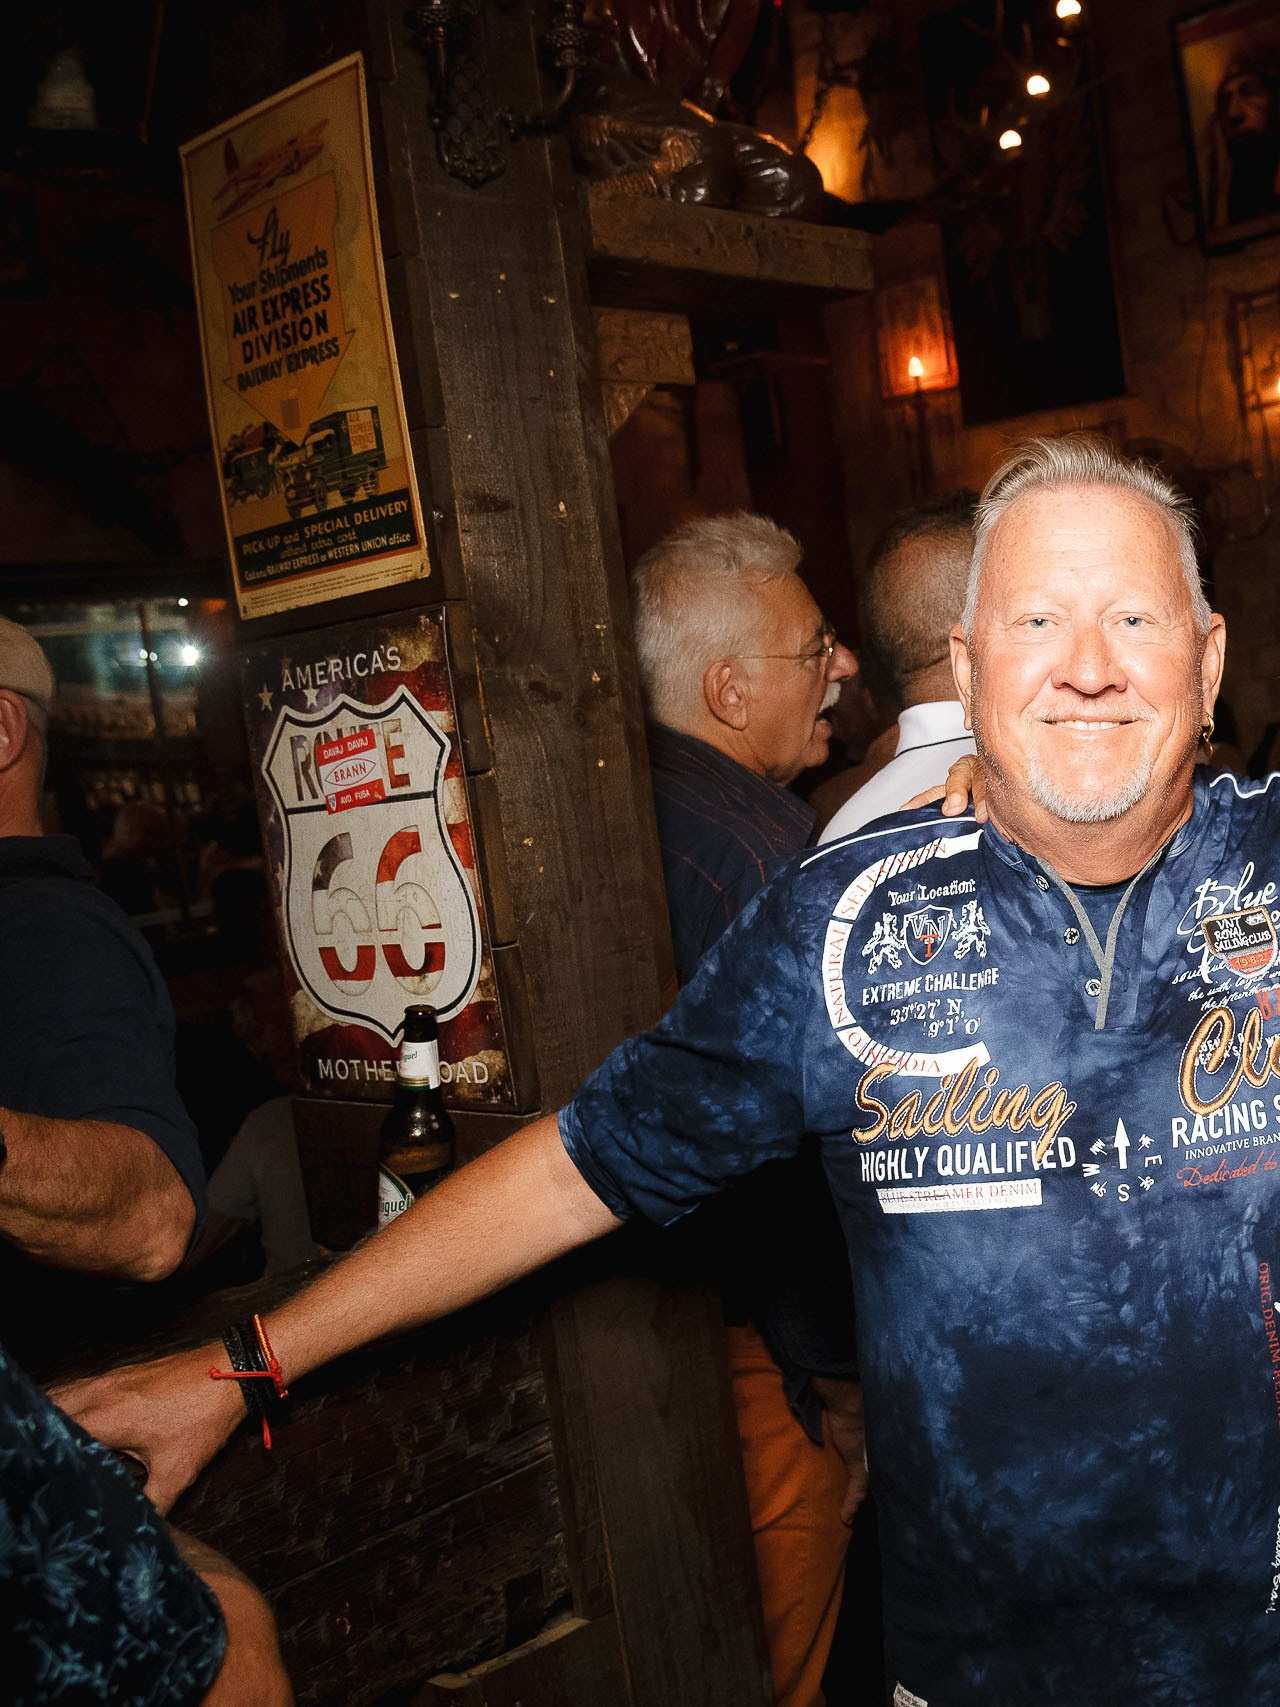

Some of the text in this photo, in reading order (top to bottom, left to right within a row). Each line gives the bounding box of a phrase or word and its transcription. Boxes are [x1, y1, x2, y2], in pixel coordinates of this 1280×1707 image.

[247, 206, 292, 265] Fly
[227, 246, 329, 305] Your Shipments
[232, 274, 331, 338] AIR EXPRESS
[242, 309, 330, 364] DIVISION
[237, 337, 340, 391] RAILWAY EXPRESS
[304, 514, 351, 538] SPECIAL
[353, 499, 409, 526] DELIVERY
[291, 552, 320, 570] EXPRESS
[327, 542, 361, 560] WESTERN
[361, 536, 388, 553] UNION
[388, 532, 412, 547] office
[281, 646, 401, 692] AMERICA'S
[290, 718, 411, 802] ROE
[323, 736, 369, 760] DAVAJ DAVAJ
[333, 762, 367, 783] BRANN
[312, 824, 446, 996] 66
[888, 889, 915, 907] Your
[1177, 862, 1278, 936] Blue
[1213, 923, 1246, 942] ROYAL
[1214, 928, 1271, 952] SAILING CLUB
[1216, 916, 1242, 930] VNT
[828, 924, 849, 1024] NATURAL
[862, 967, 1000, 1006] EXTREME CHALLENGE
[317, 1058, 490, 1085] MOTHE OAD
[852, 1056, 1078, 1164] Sailing
[1171, 1100, 1268, 1148] RACING
[860, 1137, 1077, 1182] HIGHLY QUALIFIED
[1144, 1154, 1163, 1168] E
[1176, 1150, 1264, 1187] Dedicated
[1263, 1151, 1278, 1170] to
[1184, 1138, 1251, 1160] INNOVATIVE
[989, 1182, 1038, 1198] DENIM
[1117, 1183, 1131, 1202] S
